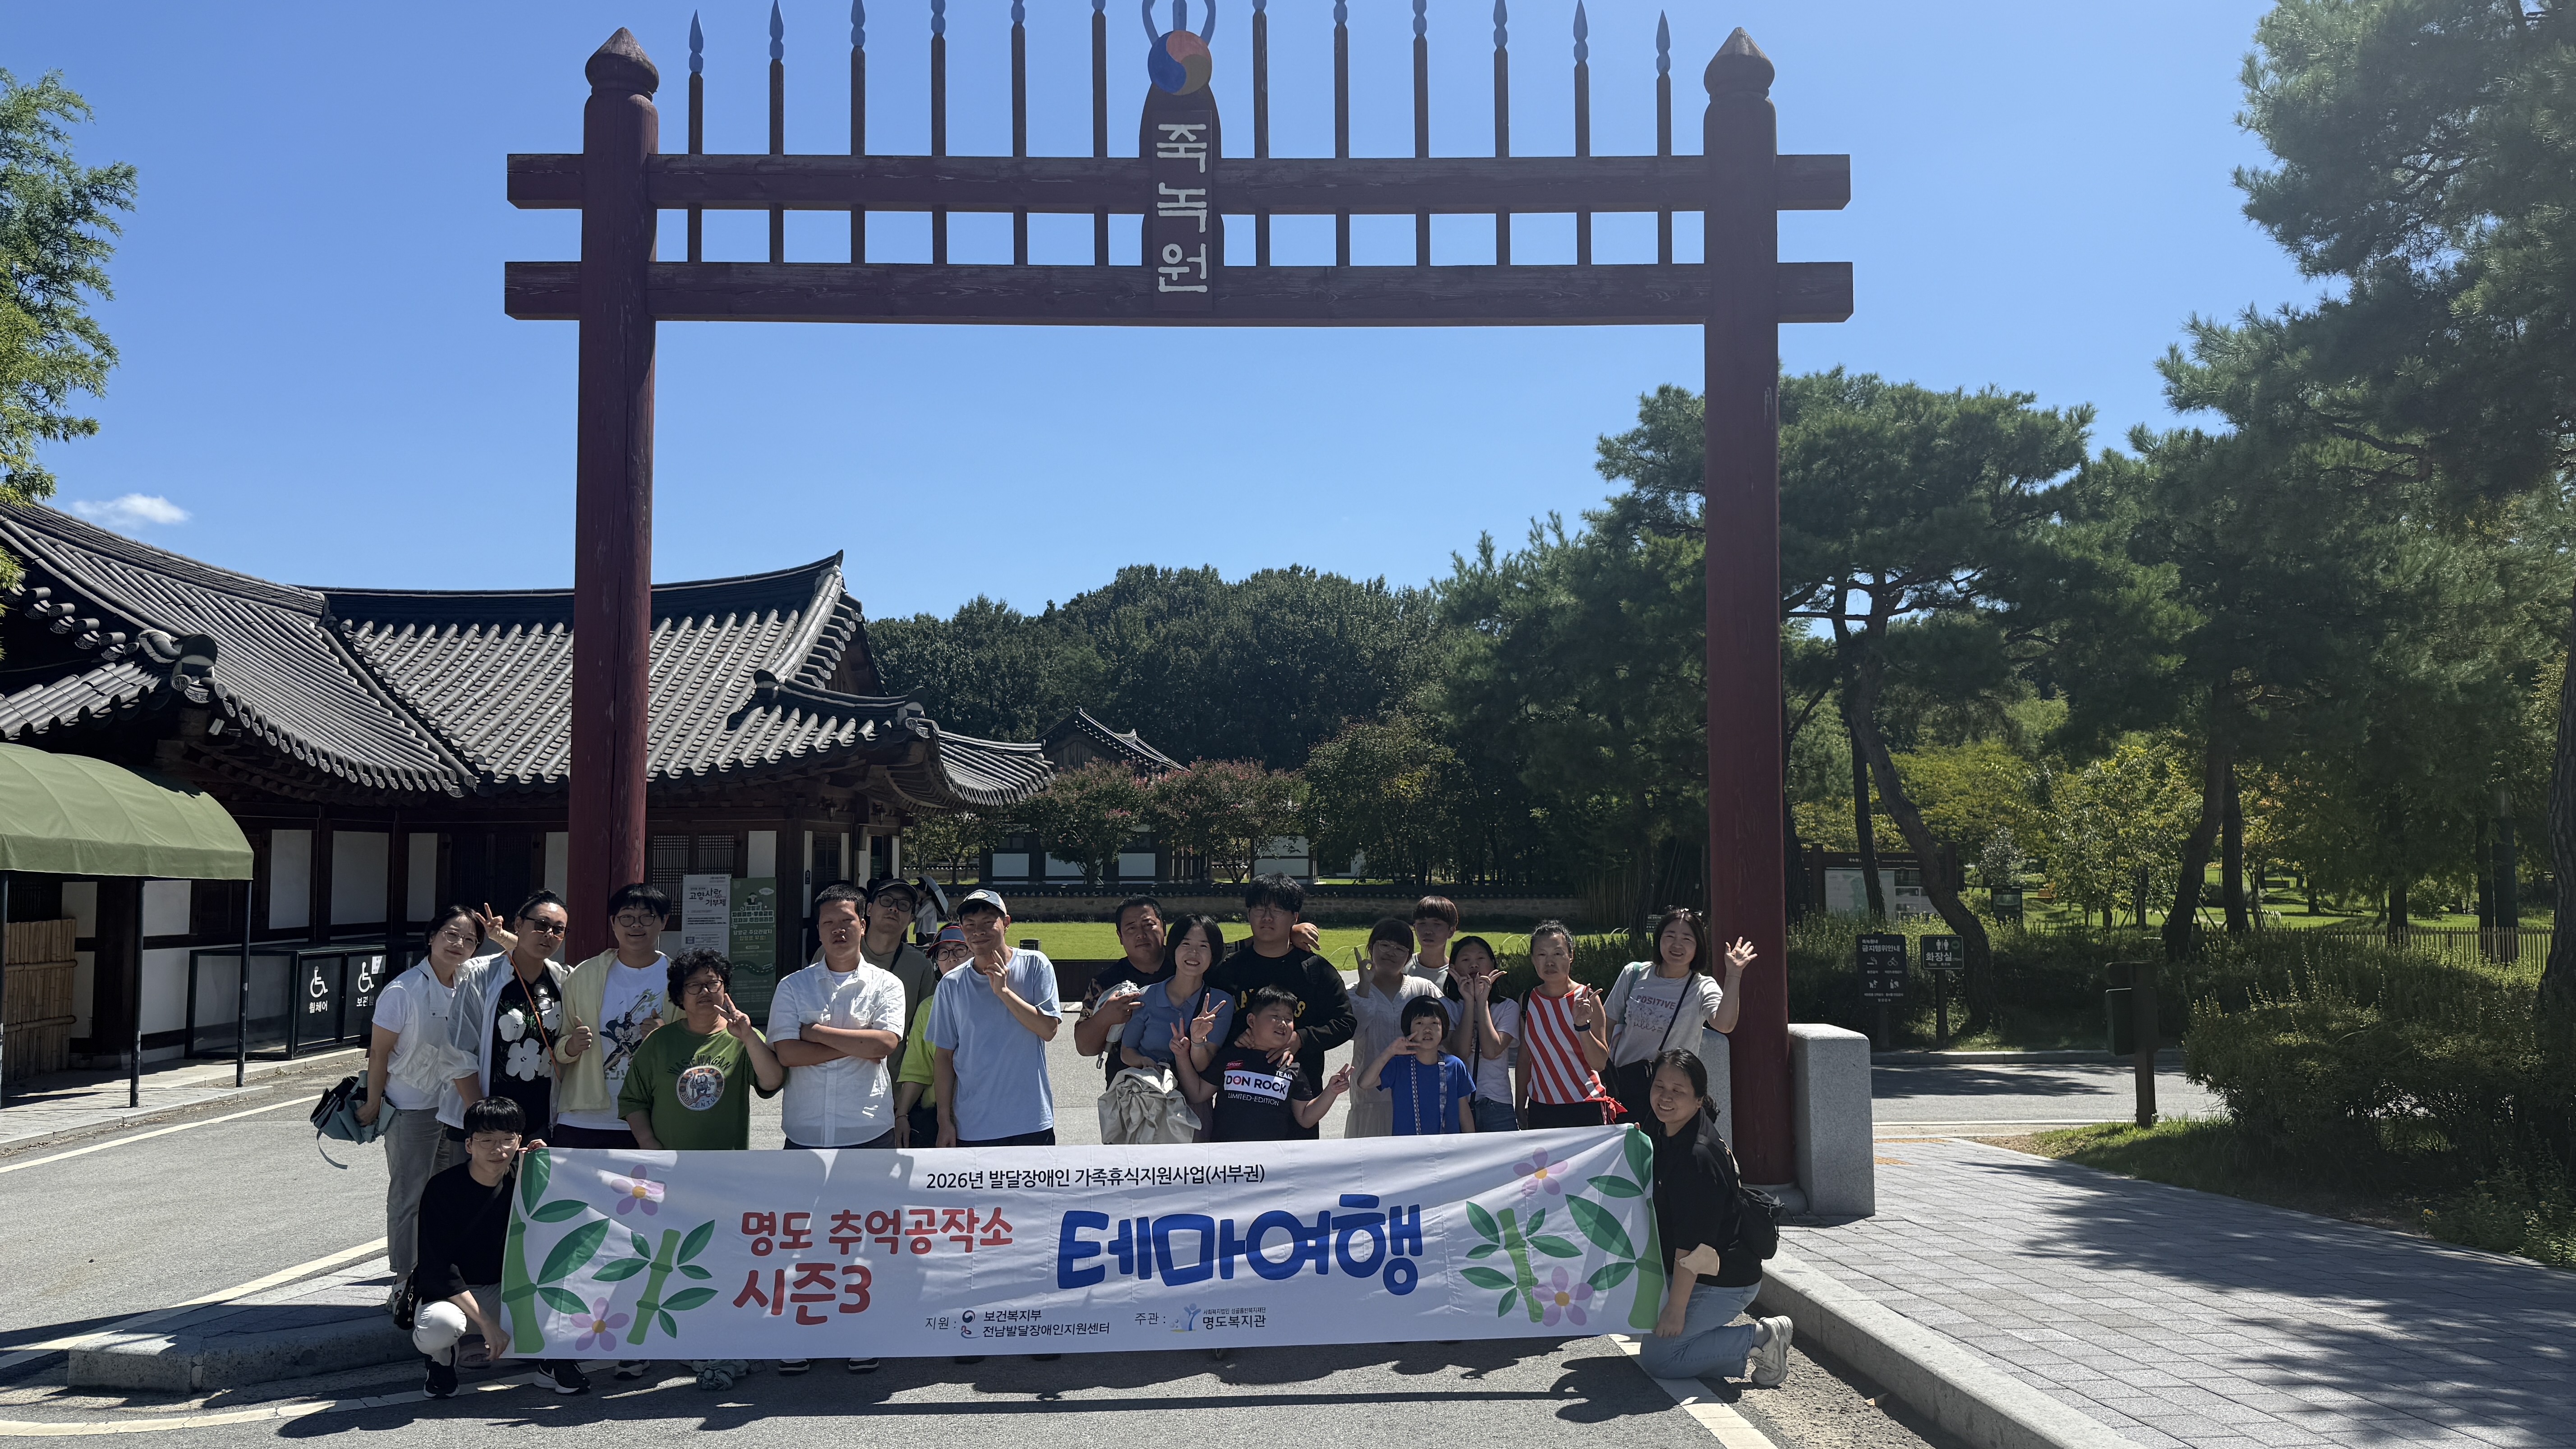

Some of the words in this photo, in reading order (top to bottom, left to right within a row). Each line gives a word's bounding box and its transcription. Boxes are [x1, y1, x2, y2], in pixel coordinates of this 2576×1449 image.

[689, 888, 722, 900] 고향사랑
[1926, 952, 1952, 961] 화장실
[309, 1000, 328, 1014] 휠체어
[1637, 995, 1676, 1010] POSITIVE
[1254, 1078, 1286, 1095] ROCK
[927, 1171, 983, 1189] 2026년
[990, 1169, 1069, 1188] 발달장애인
[1075, 1164, 1265, 1187] 가족휴식지원사업(서부권)
[741, 1212, 812, 1256] 명도
[829, 1207, 1013, 1256] 추억공작소
[1058, 1194, 1422, 1296] 테마여행
[733, 1264, 871, 1325] 시즌3
[984, 1310, 1041, 1322] 보건복지부
[1134, 1312, 1159, 1326] 주관
[1203, 1313, 1266, 1330] 명도복지관
[925, 1317, 949, 1332] 지원
[983, 1321, 1109, 1338] 전남발달장애인지원센터
